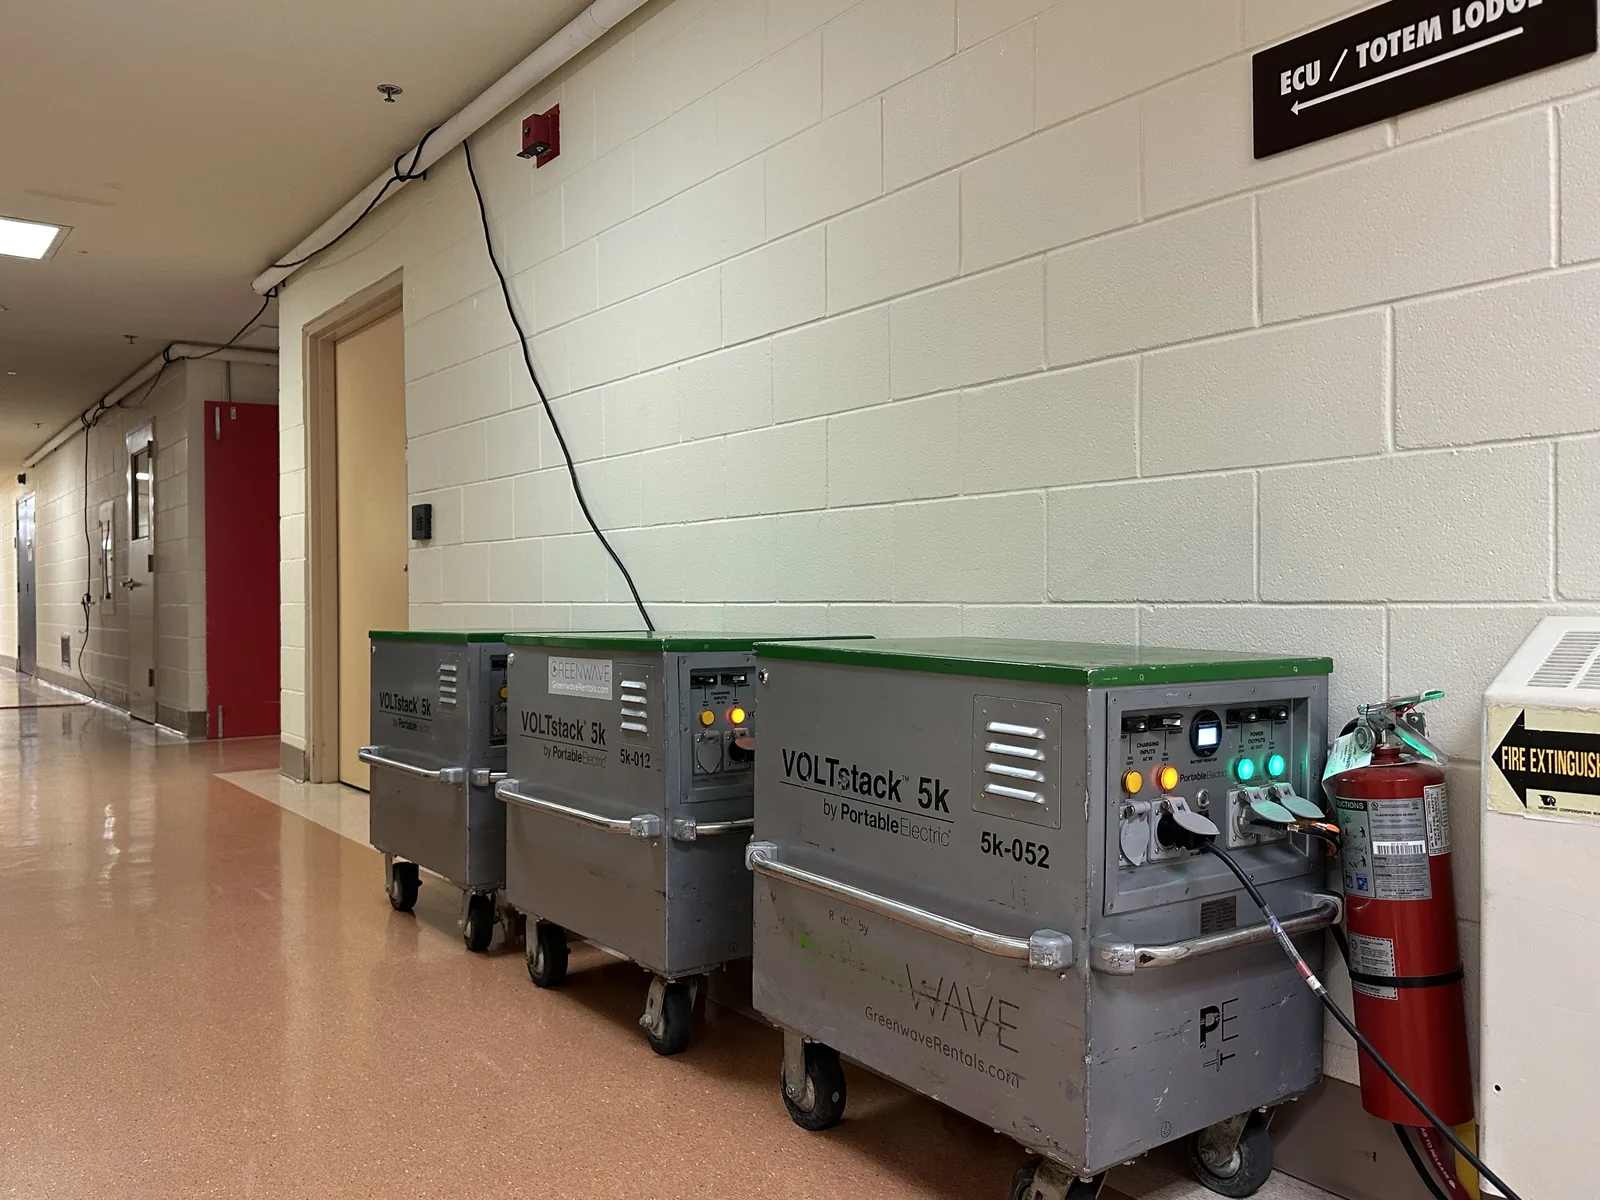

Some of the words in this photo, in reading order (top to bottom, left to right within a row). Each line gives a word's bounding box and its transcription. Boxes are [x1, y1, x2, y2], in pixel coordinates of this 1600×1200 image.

[1280, 59, 1321, 96] ECU
[1355, 15, 1442, 69] TOTEM
[551, 660, 610, 683] GREENWAVE
[421, 698, 432, 716] 5k
[591, 721, 606, 746] 5k
[543, 744, 552, 760] by
[620, 748, 651, 769] 5k-012
[1501, 745, 1526, 772] FIRE
[917, 776, 950, 814] 5k
[823, 798, 838, 821] by
[980, 831, 1050, 869] 5k-052
[858, 919, 869, 936] by
[864, 1005, 1020, 1089] GreenwaveRentals.com
